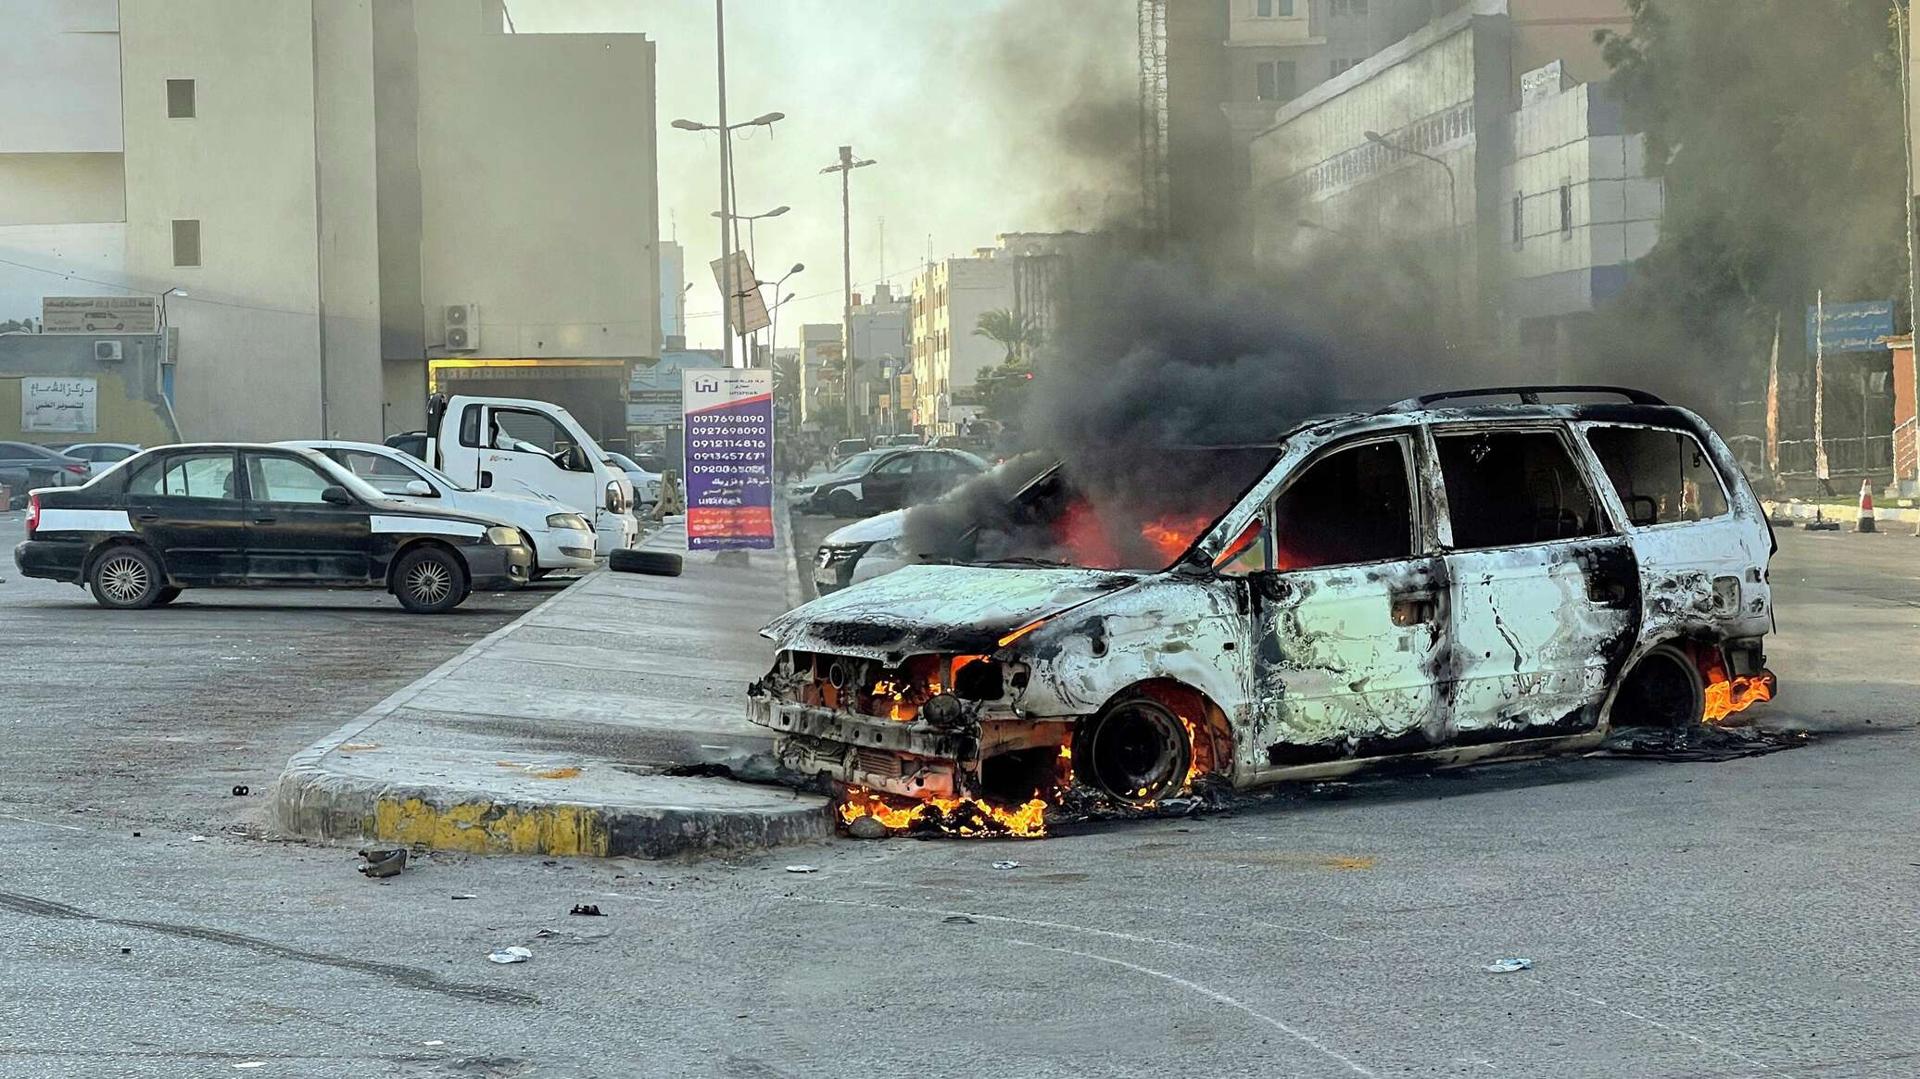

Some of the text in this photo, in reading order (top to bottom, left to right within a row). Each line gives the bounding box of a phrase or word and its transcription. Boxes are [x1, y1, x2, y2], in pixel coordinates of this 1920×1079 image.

[693, 415, 764, 423] 0917698090
[692, 427, 766, 435] 0927698090
[692, 440, 766, 448] 0912114816
